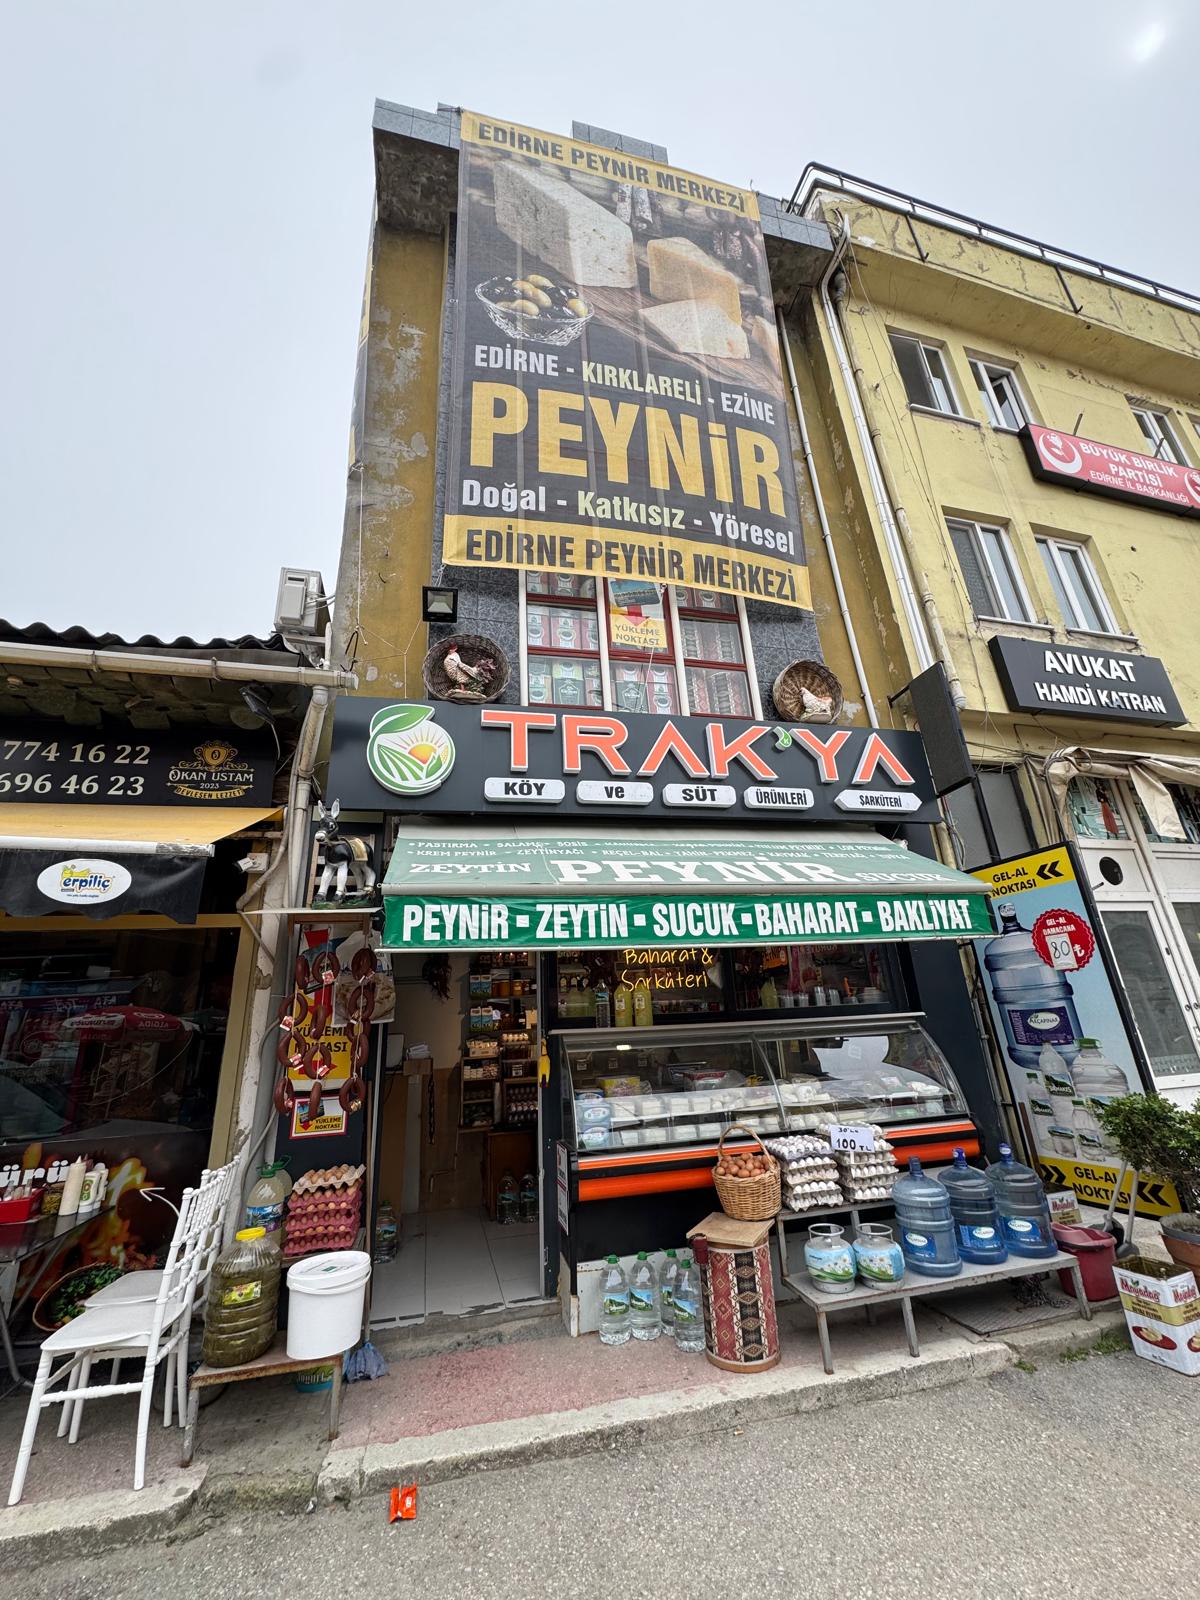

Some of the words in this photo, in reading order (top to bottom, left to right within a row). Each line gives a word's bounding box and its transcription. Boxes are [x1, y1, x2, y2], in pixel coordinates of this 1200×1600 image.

[478, 121, 563, 160] EDİRNE
[571, 149, 650, 185] PEYNİR
[656, 170, 746, 212] MERKEZİ
[475, 344, 558, 377] EDİRNE
[582, 361, 701, 404] KIRKLARELİ
[721, 392, 775, 424] EZİNE
[470, 381, 786, 517] PEYNİR
[1079, 442, 1130, 464] BÜYÜK
[1130, 456, 1178, 478] BİRLİK
[1090, 470, 1125, 487] EDİRNE
[1126, 479, 1135, 489] İL
[1135, 483, 1190, 503] BAŞKANLIĞI
[1109, 463, 1163, 487] PARTİSİ
[462, 480, 546, 513] Doğal
[577, 490, 685, 530] Katkısız
[710, 512, 795, 556] Yöresel
[466, 529, 575, 568] EDİRNE
[585, 541, 683, 581] PEYNİR
[694, 556, 797, 602] MERKEZİ
[615, 624, 660, 636] YÜKLEME
[616, 633, 660, 646] NOKTASI
[1044, 650, 1136, 682] AVUKAT
[1034, 682, 1097, 707] HAMDİ
[1097, 689, 1167, 714] KATRAN
[4, 741, 60, 762] 774
[70, 744, 106, 763] 16
[113, 745, 150, 765] 22
[60, 774, 100, 795] 46
[107, 775, 145, 796] 23
[169, 769, 207, 782] OKAN
[212, 772, 253, 782] USTAM
[504, 780, 545, 796] KÖY
[605, 785, 625, 799] ve
[682, 786, 717, 802] SÜT
[756, 788, 808, 806] ÜRÜNLERİ
[409, 861, 531, 874] ZEYTİN
[550, 857, 861, 881] PEYNİR
[855, 872, 957, 881] SUCUK
[992, 867, 1028, 883] GEL-AL
[63, 875, 111, 891] erpiliç
[991, 879, 1037, 897] NOKTASI
[402, 904, 509, 941] PEYNİR
[536, 904, 629, 939] ZEYTİN
[652, 903, 740, 938] SUCUK
[755, 901, 859, 936] BAHARAT
[877, 899, 972, 932] BAKLİYAT
[1046, 916, 1068, 926] GEL-AL
[623, 947, 697, 965] Baharat
[1051, 940, 1070, 959] 80
[836, 1138, 856, 1150] 100
